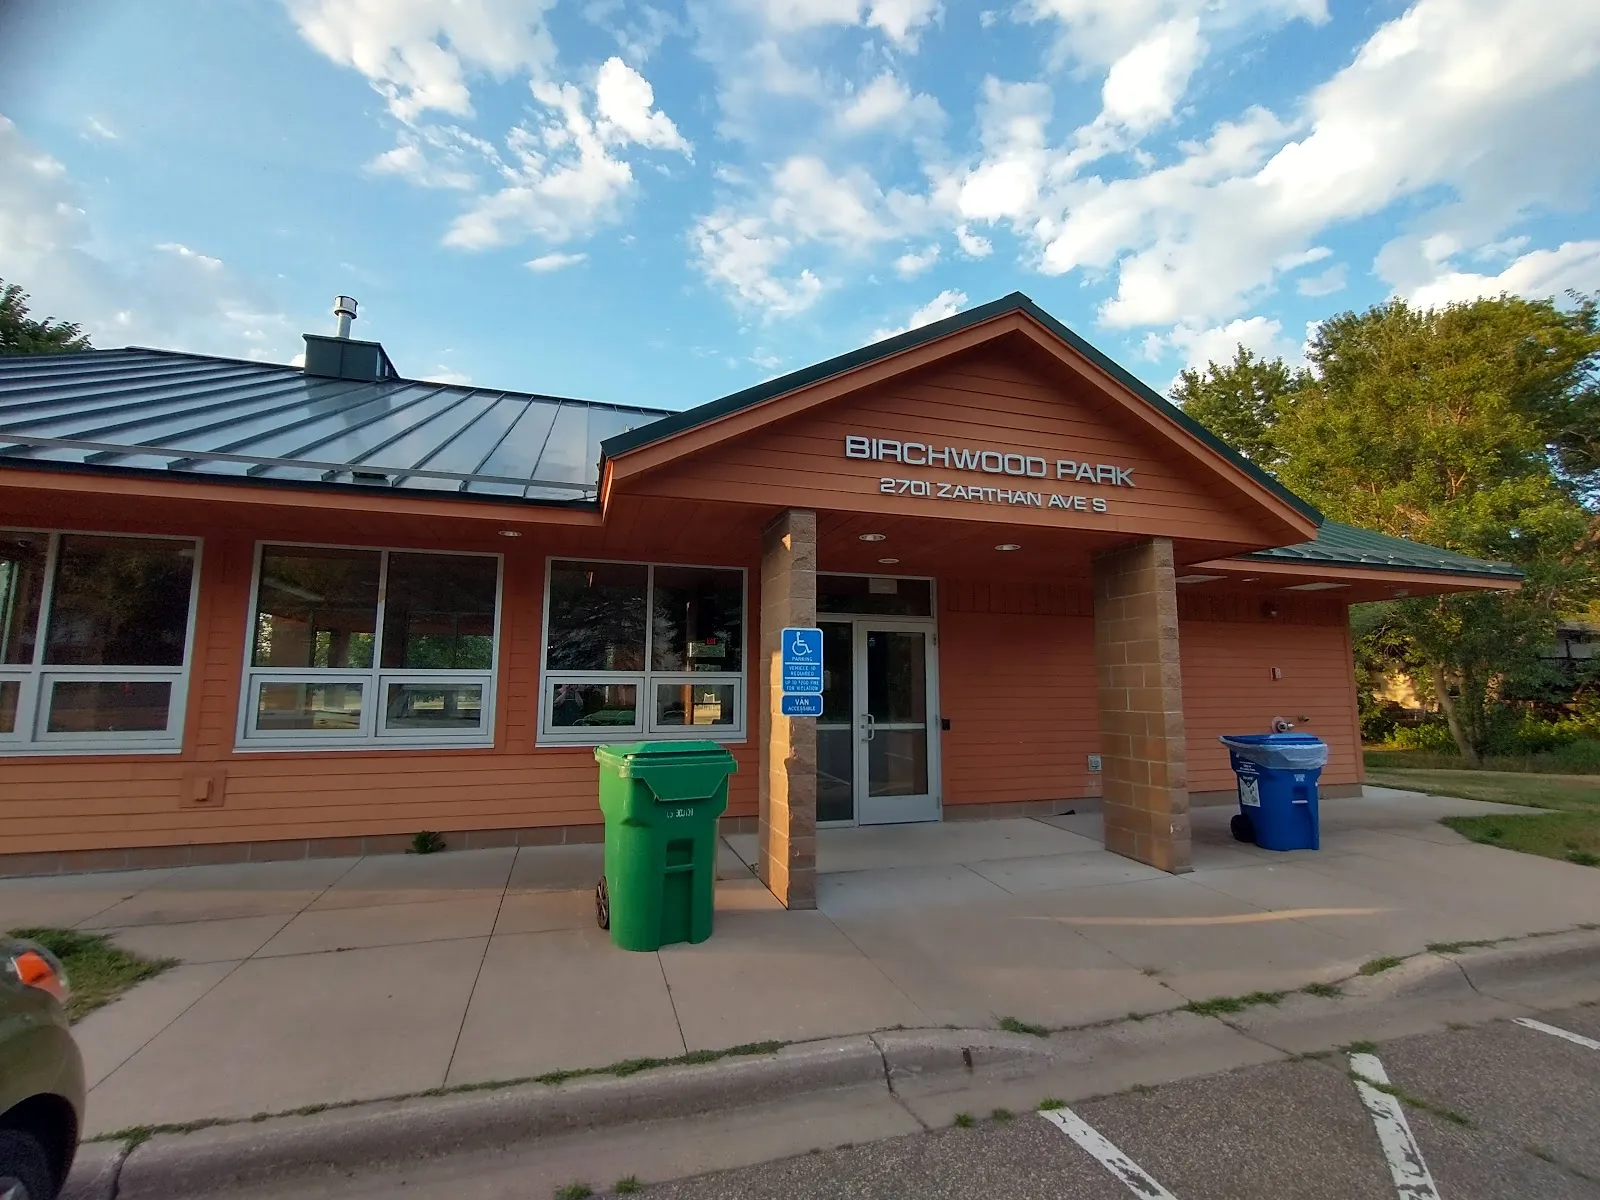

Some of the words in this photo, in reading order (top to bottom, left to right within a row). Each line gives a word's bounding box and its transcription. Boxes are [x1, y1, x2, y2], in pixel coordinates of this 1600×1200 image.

[845, 435, 1047, 477] BIRCHWOOD
[1056, 459, 1136, 487] PARK
[880, 477, 931, 496] 2701
[936, 482, 1042, 506] ZARTHAN
[1047, 494, 1088, 510] AVE
[1092, 497, 1107, 512] S
